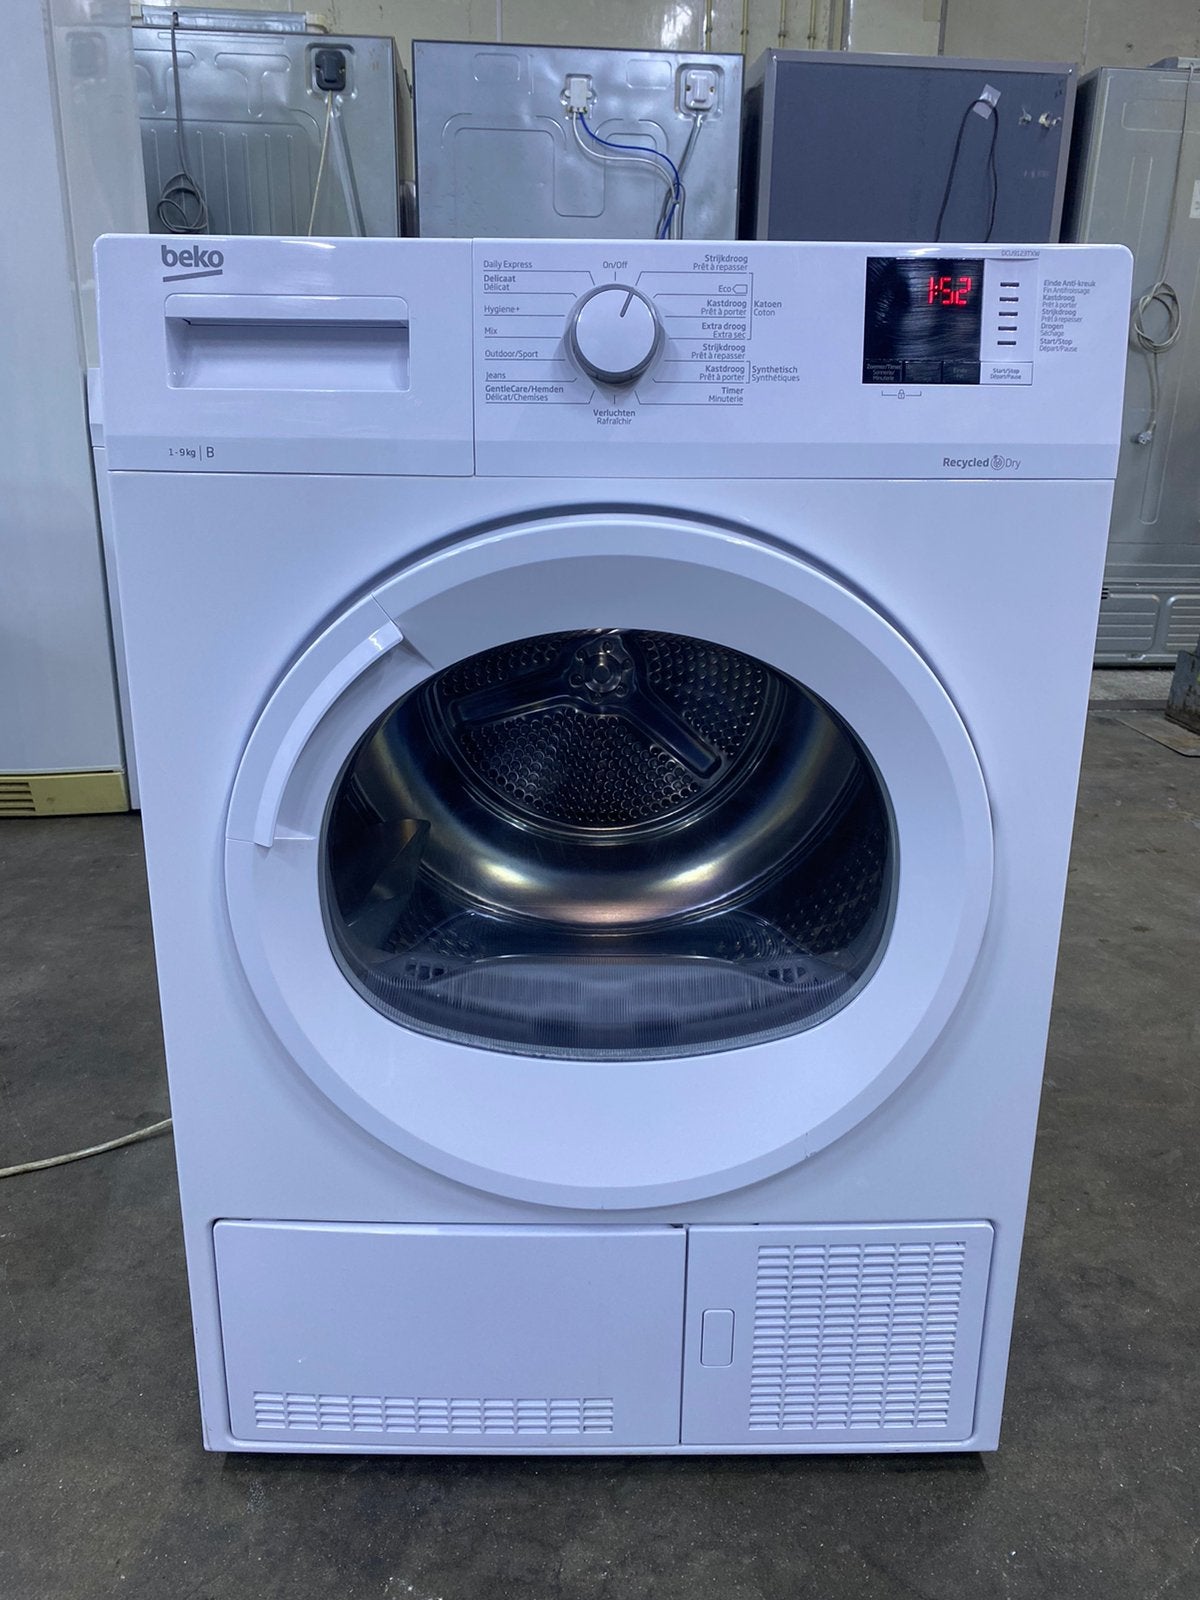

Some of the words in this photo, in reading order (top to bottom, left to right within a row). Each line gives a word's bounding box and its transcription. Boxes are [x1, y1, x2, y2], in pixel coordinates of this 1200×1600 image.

[161, 245, 224, 268] beko
[705, 255, 748, 264] Strijkdroog
[483, 260, 501, 269] Daily
[503, 260, 533, 269] Express
[602, 261, 628, 269] On/Off
[693, 263, 709, 271] Prêt
[716, 264, 748, 272] repasser
[484, 283, 510, 291] Délicat
[718, 285, 732, 293] Eco
[928, 276, 972, 305] 1:52
[707, 300, 747, 309] Kastdroog
[754, 300, 782, 308] Katoen
[484, 305, 520, 313] Hygiene+
[701, 308, 716, 316] Prêt
[723, 309, 746, 317] porter
[702, 322, 722, 330] Extra
[723, 322, 746, 332] droog
[713, 331, 733, 339] Extra
[703, 344, 745, 353] Strijkdroog
[485, 350, 538, 358] Outdoor/Sport
[691, 352, 707, 360] Prêt
[714, 353, 745, 361] repasser
[705, 365, 745, 374] Kastdroog
[752, 366, 798, 374] Synthetisch
[485, 372, 506, 380] Jeans
[700, 373, 715, 381] Prêt
[722, 374, 745, 382] porter
[752, 374, 800, 382] Synthétiques
[485, 385, 564, 393] GentleCare/Hemden
[485, 393, 548, 401] Délicat/Chemises
[708, 395, 743, 403] Minuterie
[593, 409, 636, 417] Verluchten
[596, 417, 632, 425] Rafraîchir
[206, 446, 215, 458] B
[943, 457, 989, 469] Recycled
[1005, 458, 1021, 470] Dry
